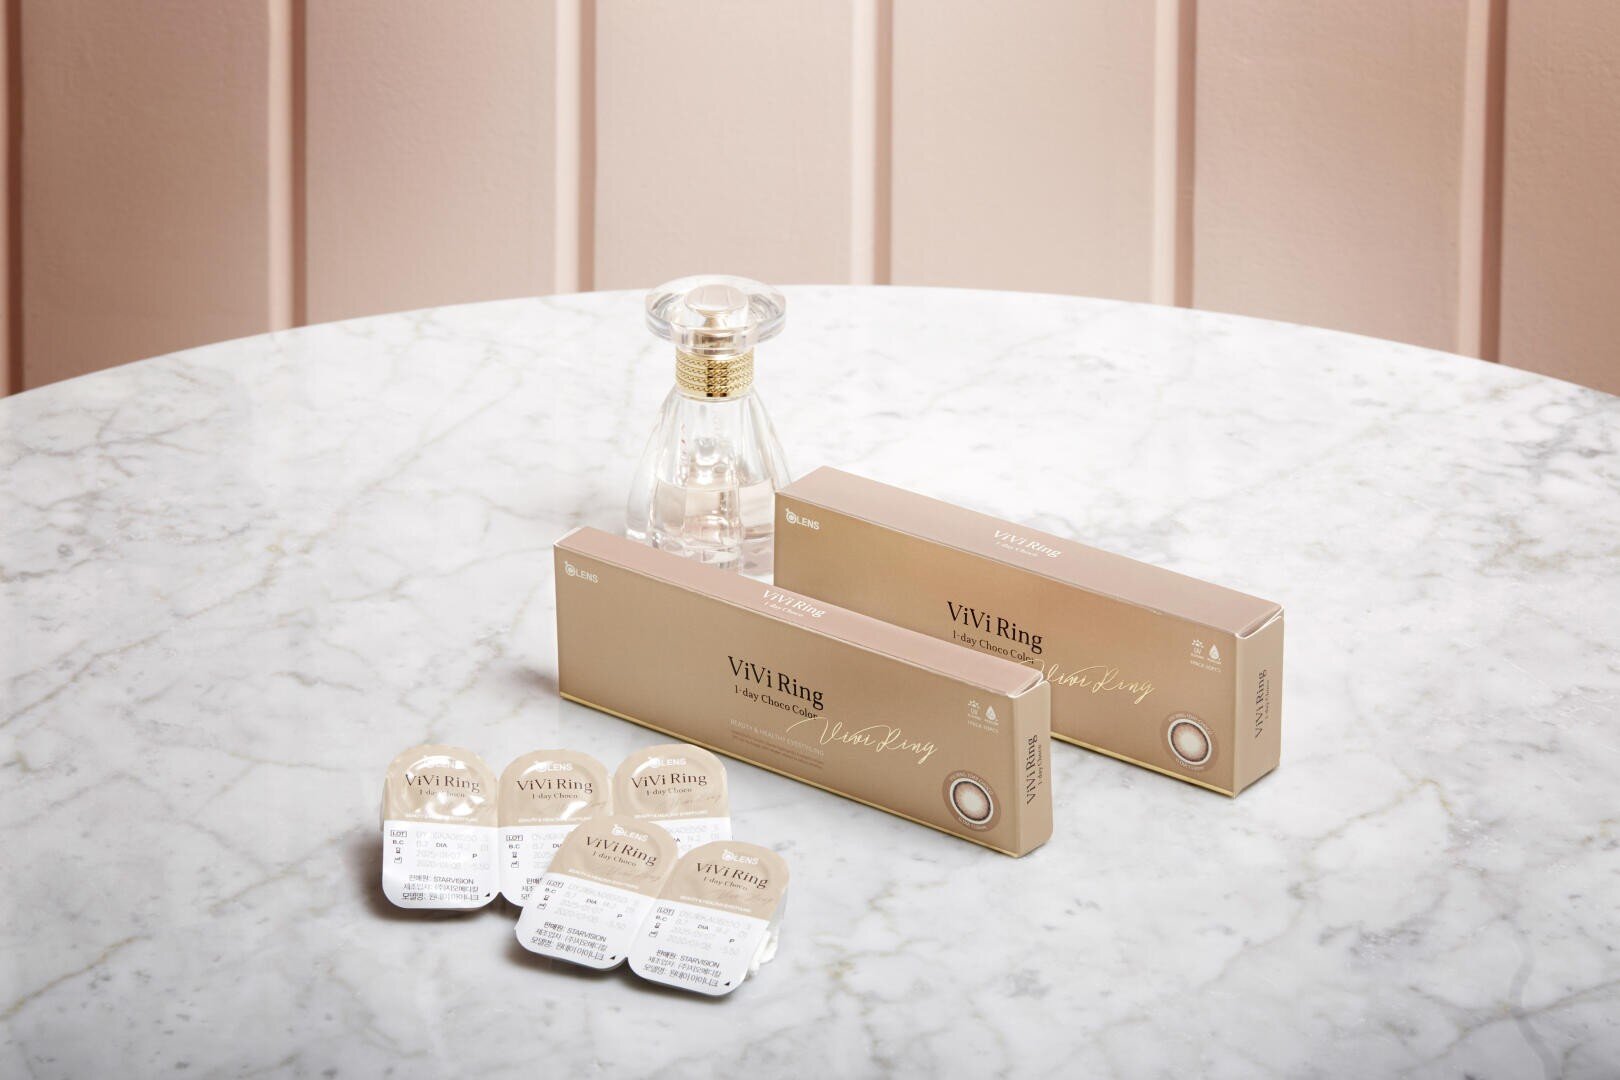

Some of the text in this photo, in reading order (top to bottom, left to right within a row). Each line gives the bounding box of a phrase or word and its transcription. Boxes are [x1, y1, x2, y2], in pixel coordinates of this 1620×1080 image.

[994, 530, 1063, 558] ViVi Ring
[763, 590, 826, 618] ViVi Ring
[947, 600, 1043, 654] ViVi Ring
[952, 630, 977, 647] 1-day
[979, 640, 1008, 656] Choco
[728, 655, 824, 711] ViVi Ring
[734, 685, 818, 720] 1-day Choco Color
[1255, 669, 1267, 738] ViVi Ring
[405, 773, 480, 793] ViVi Ring
[631, 773, 708, 788] ViVi Ring
[1026, 734, 1038, 805] ViVi Ring
[516, 778, 593, 794] ViVi Ring
[585, 836, 619, 852] ViVi
[621, 844, 657, 867] Ring
[433, 875, 474, 885] STARVISION
[696, 862, 769, 889] ViVi Ring
[566, 927, 607, 942] STARVISION
[679, 954, 720, 968] STARVISION
